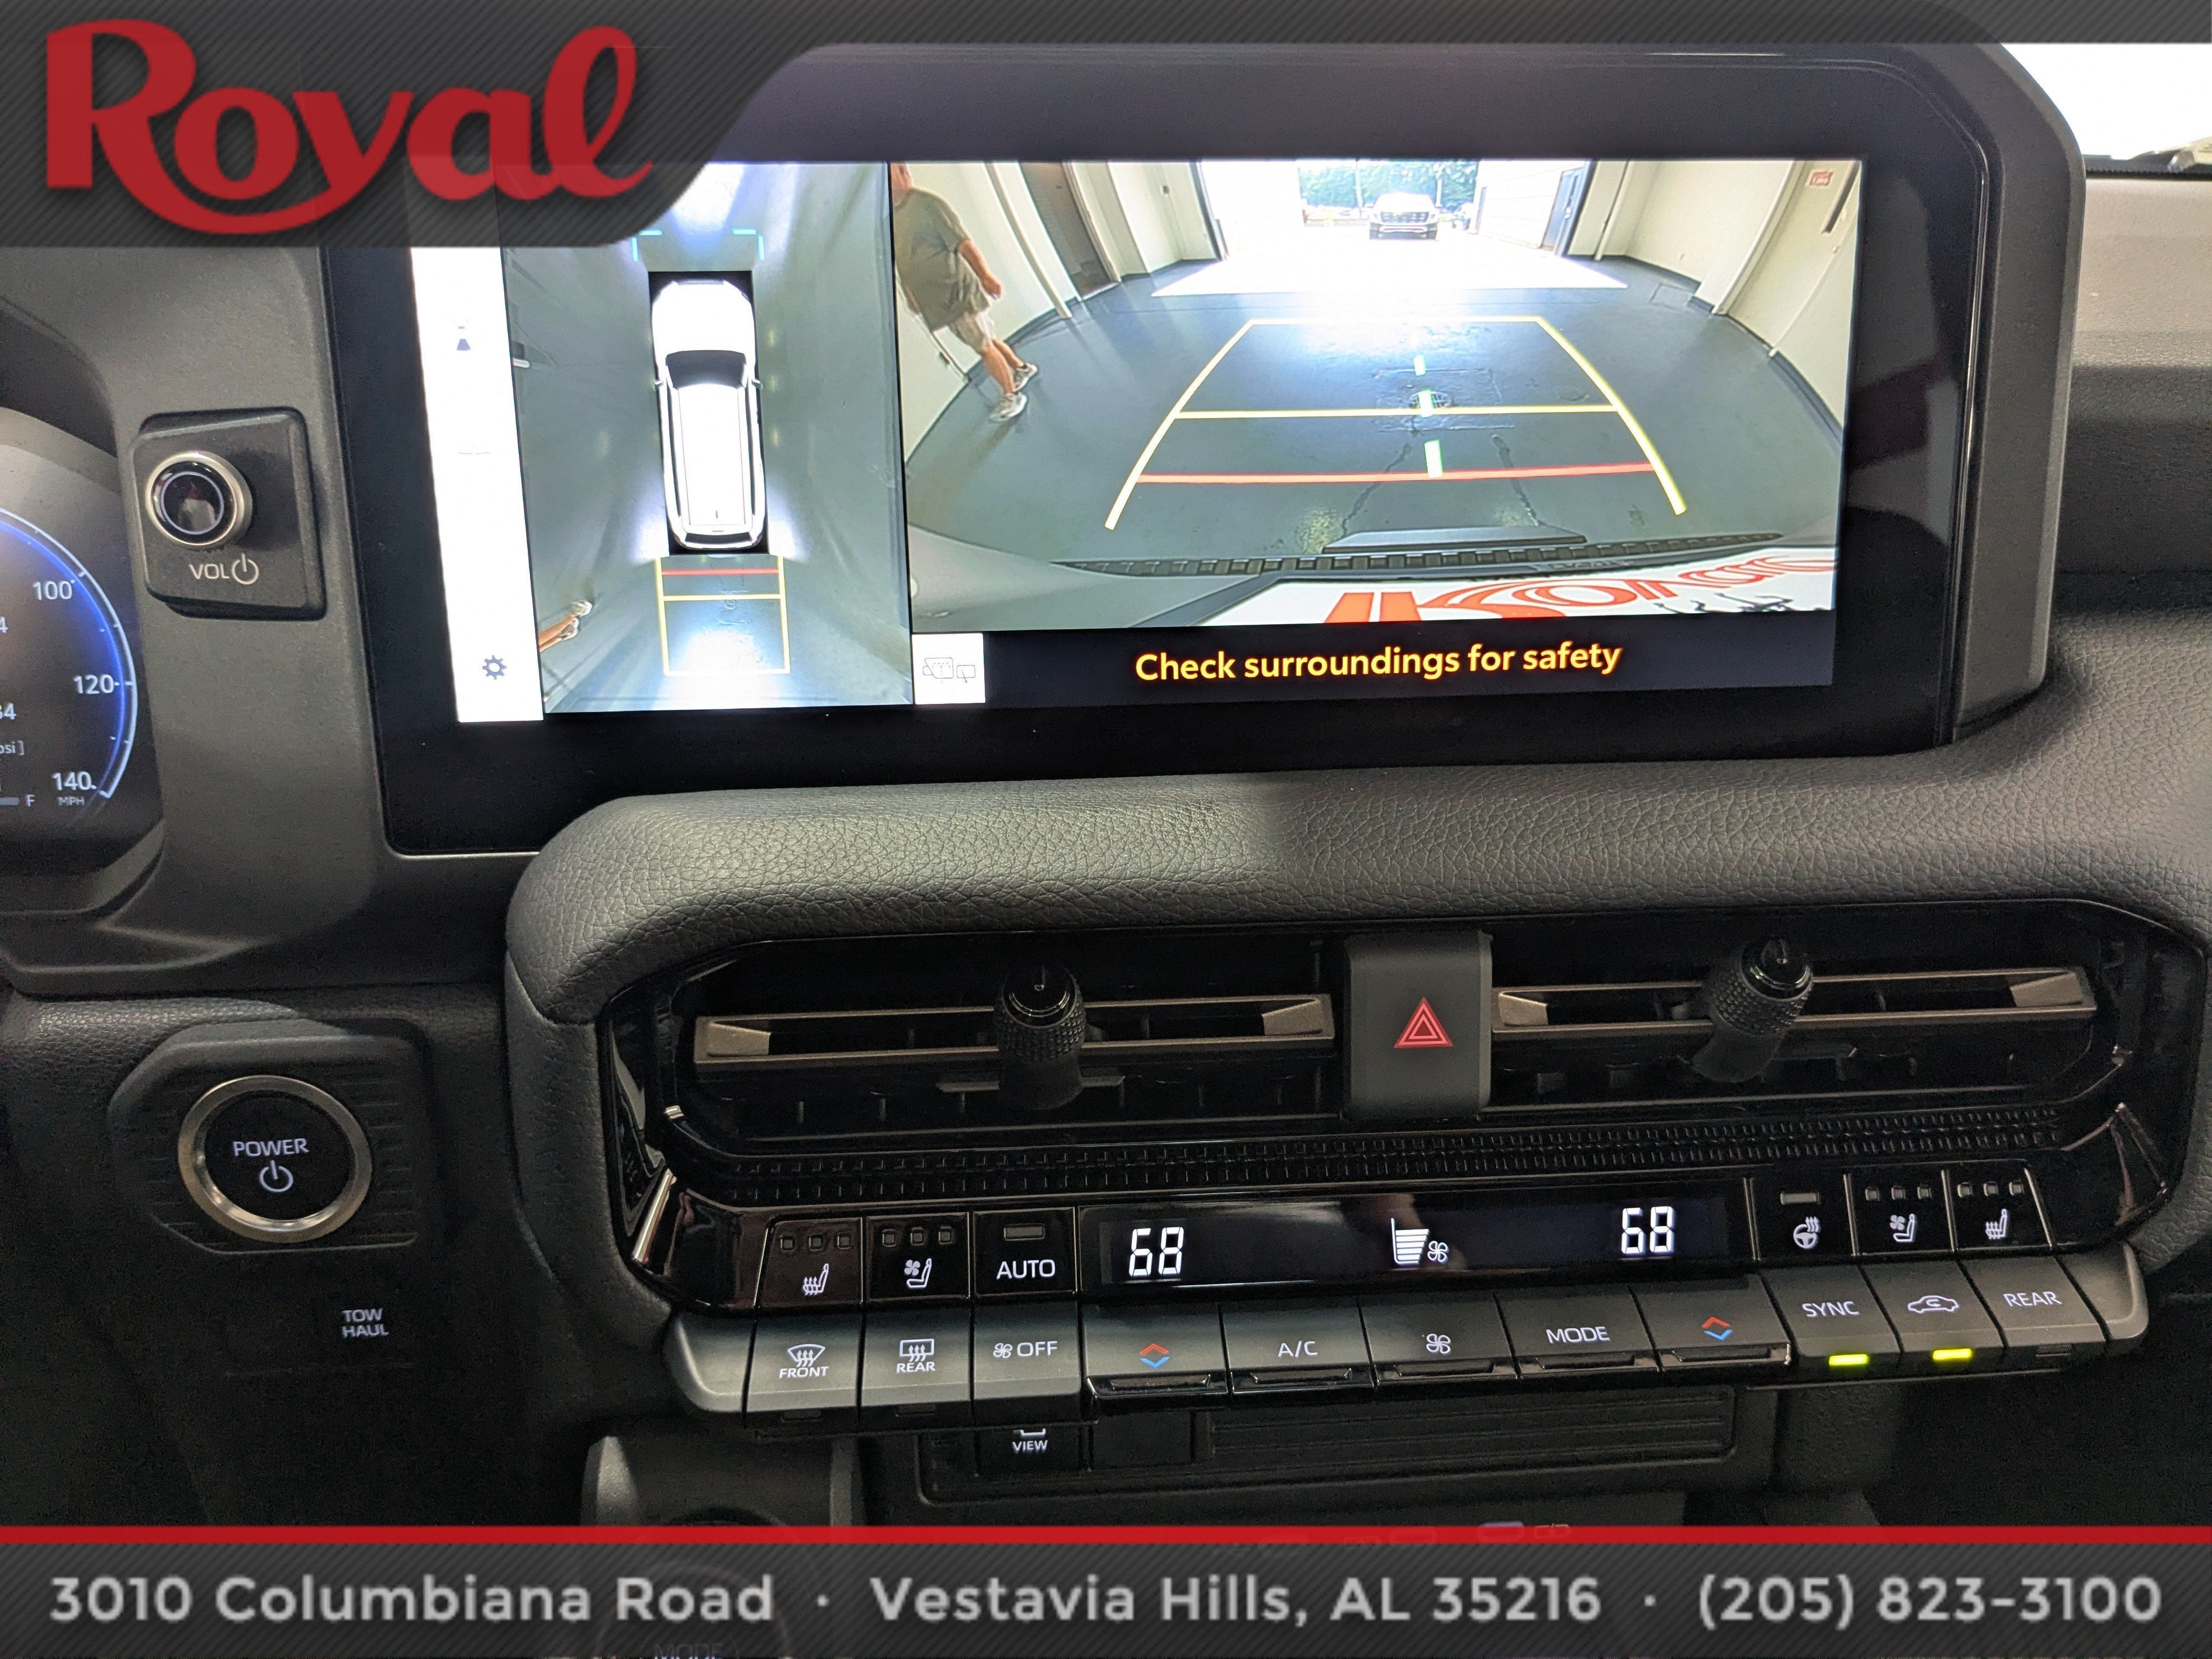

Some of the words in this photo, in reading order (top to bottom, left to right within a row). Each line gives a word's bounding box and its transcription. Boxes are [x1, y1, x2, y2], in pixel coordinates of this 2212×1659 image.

[189, 563, 230, 579] VOL
[33, 580, 73, 600] 100
[1135, 650, 1237, 680] Check
[1244, 645, 1460, 680] surroundings
[1468, 643, 1516, 672] for
[1523, 640, 1622, 675] safety
[74, 675, 114, 694] 120
[53, 771, 92, 791] 140
[26, 794, 35, 807] F
[58, 796, 84, 805] MPH
[232, 1138, 309, 1156] POWER
[1621, 1205, 1675, 1255] 68
[1128, 1226, 1184, 1278] 68
[996, 1259, 1056, 1279] AUTO
[2003, 1290, 2062, 1307] REAR
[342, 1308, 382, 1323] TOW
[1802, 1301, 1859, 1317] SYNC
[342, 1324, 389, 1338] HAUL
[1546, 1325, 1611, 1344] MODE
[1017, 1340, 1058, 1357] OFF
[1278, 1340, 1318, 1358] A/C
[779, 1364, 829, 1379] FRONT
[896, 1361, 936, 1373] REAR
[1012, 1440, 1048, 1452] VIEW
